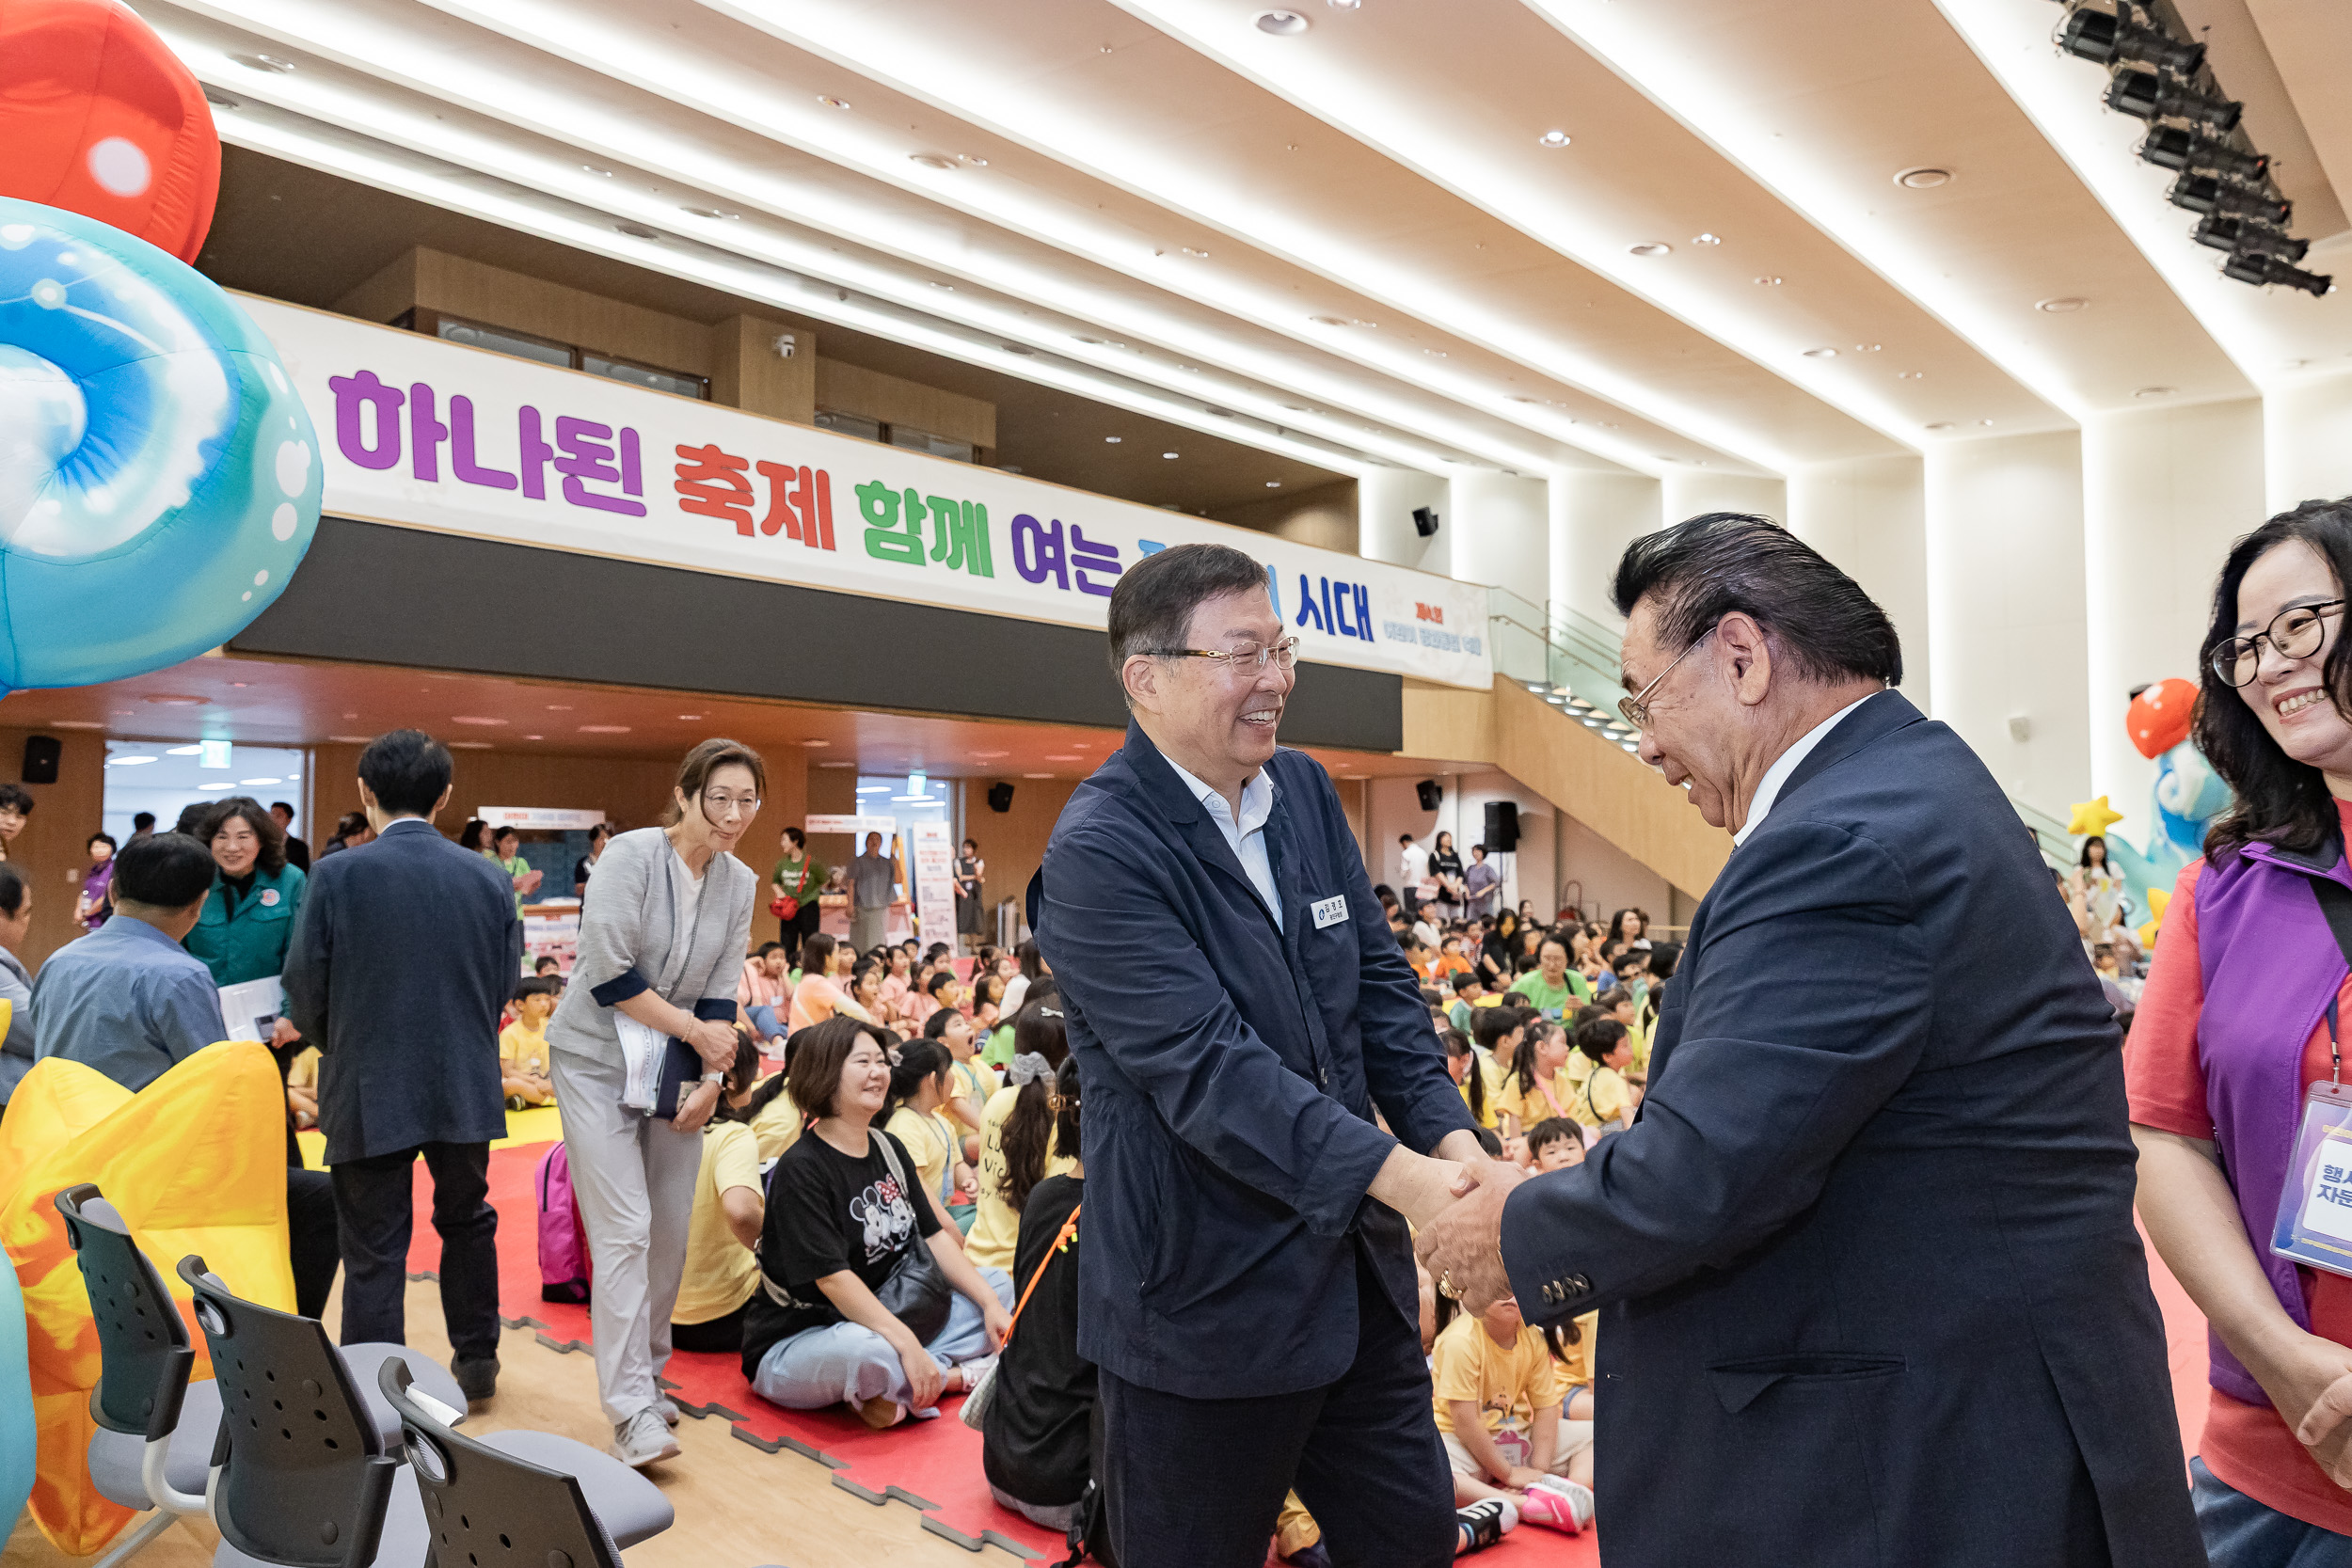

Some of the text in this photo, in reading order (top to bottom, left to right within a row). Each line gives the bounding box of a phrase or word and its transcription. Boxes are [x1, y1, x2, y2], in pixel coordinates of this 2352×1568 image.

[329, 370, 647, 517] 하나된
[674, 444, 836, 551] 축제
[854, 480, 994, 579] 함께
[1010, 513, 1123, 598] 여는
[1295, 573, 1375, 643] 시대
